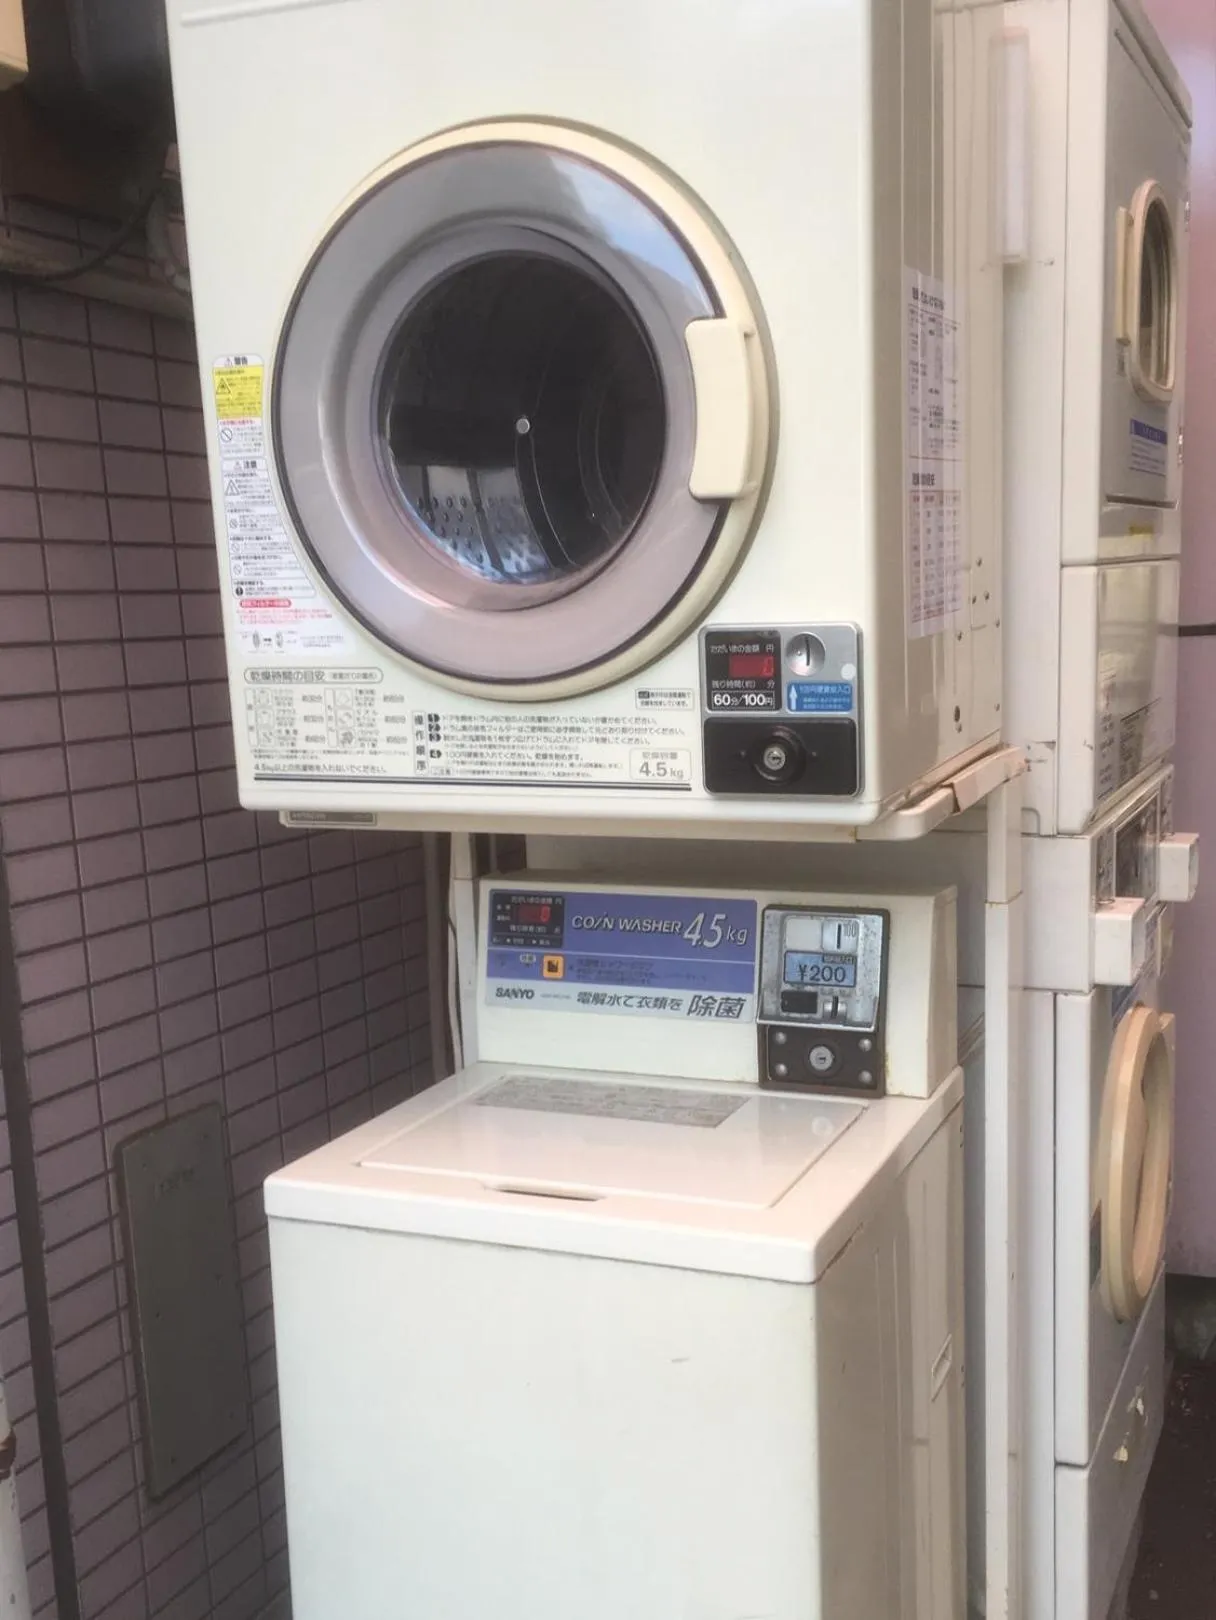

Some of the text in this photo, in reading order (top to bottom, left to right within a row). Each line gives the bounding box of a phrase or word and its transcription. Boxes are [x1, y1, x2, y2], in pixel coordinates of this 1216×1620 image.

[766, 644, 774, 653] 円
[250, 671, 326, 682] 乾燥時間の目安
[766, 680, 776, 689] 分
[619, 917, 683, 934] WASHER
[798, 964, 847, 983] ¥200
[494, 986, 537, 1001] SANYO
[576, 990, 747, 1019] 電解水で衣類を 除菌
